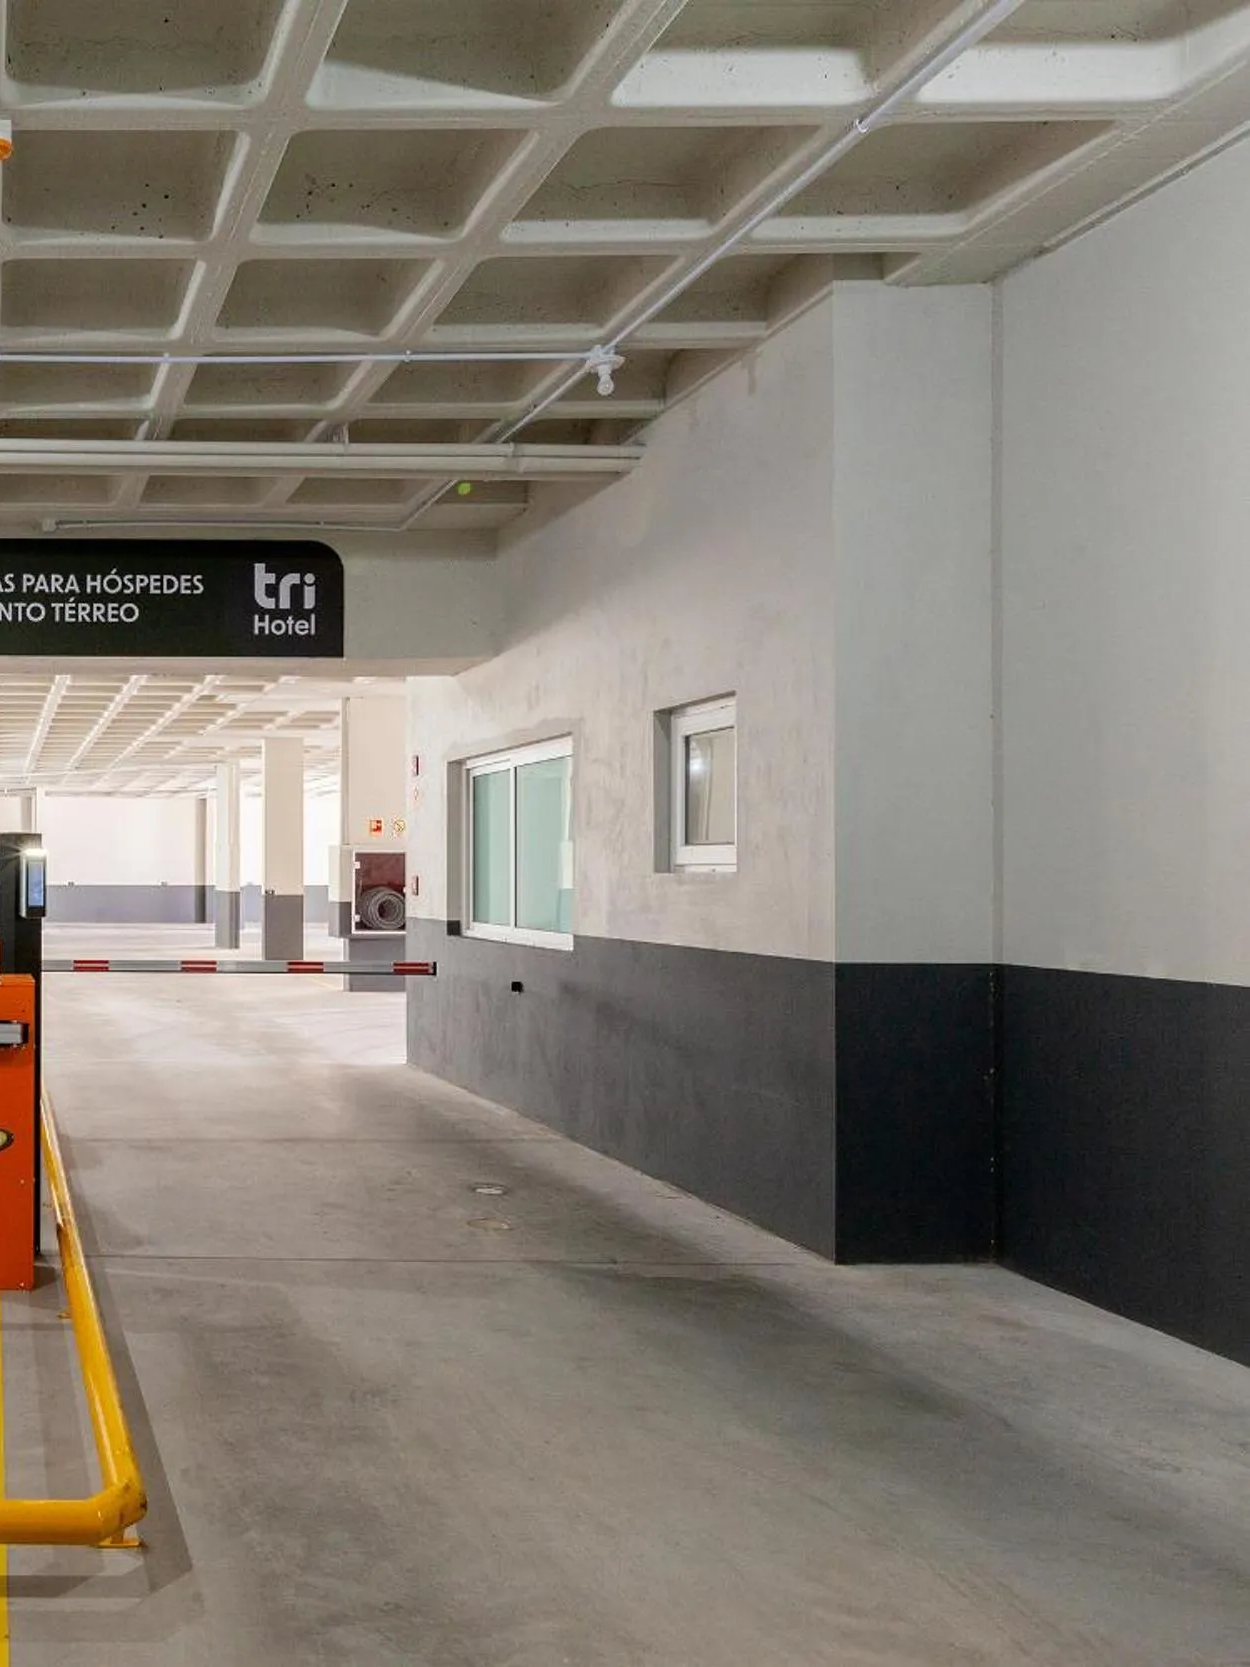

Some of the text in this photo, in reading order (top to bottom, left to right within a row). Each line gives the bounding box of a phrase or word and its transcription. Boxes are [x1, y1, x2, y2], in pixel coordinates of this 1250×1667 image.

[22, 573, 81, 594] PARA
[86, 568, 204, 594] HÓSPEDES
[254, 562, 316, 610] tri
[50, 596, 140, 623] TÉRREO
[253, 613, 316, 636] Hotel
